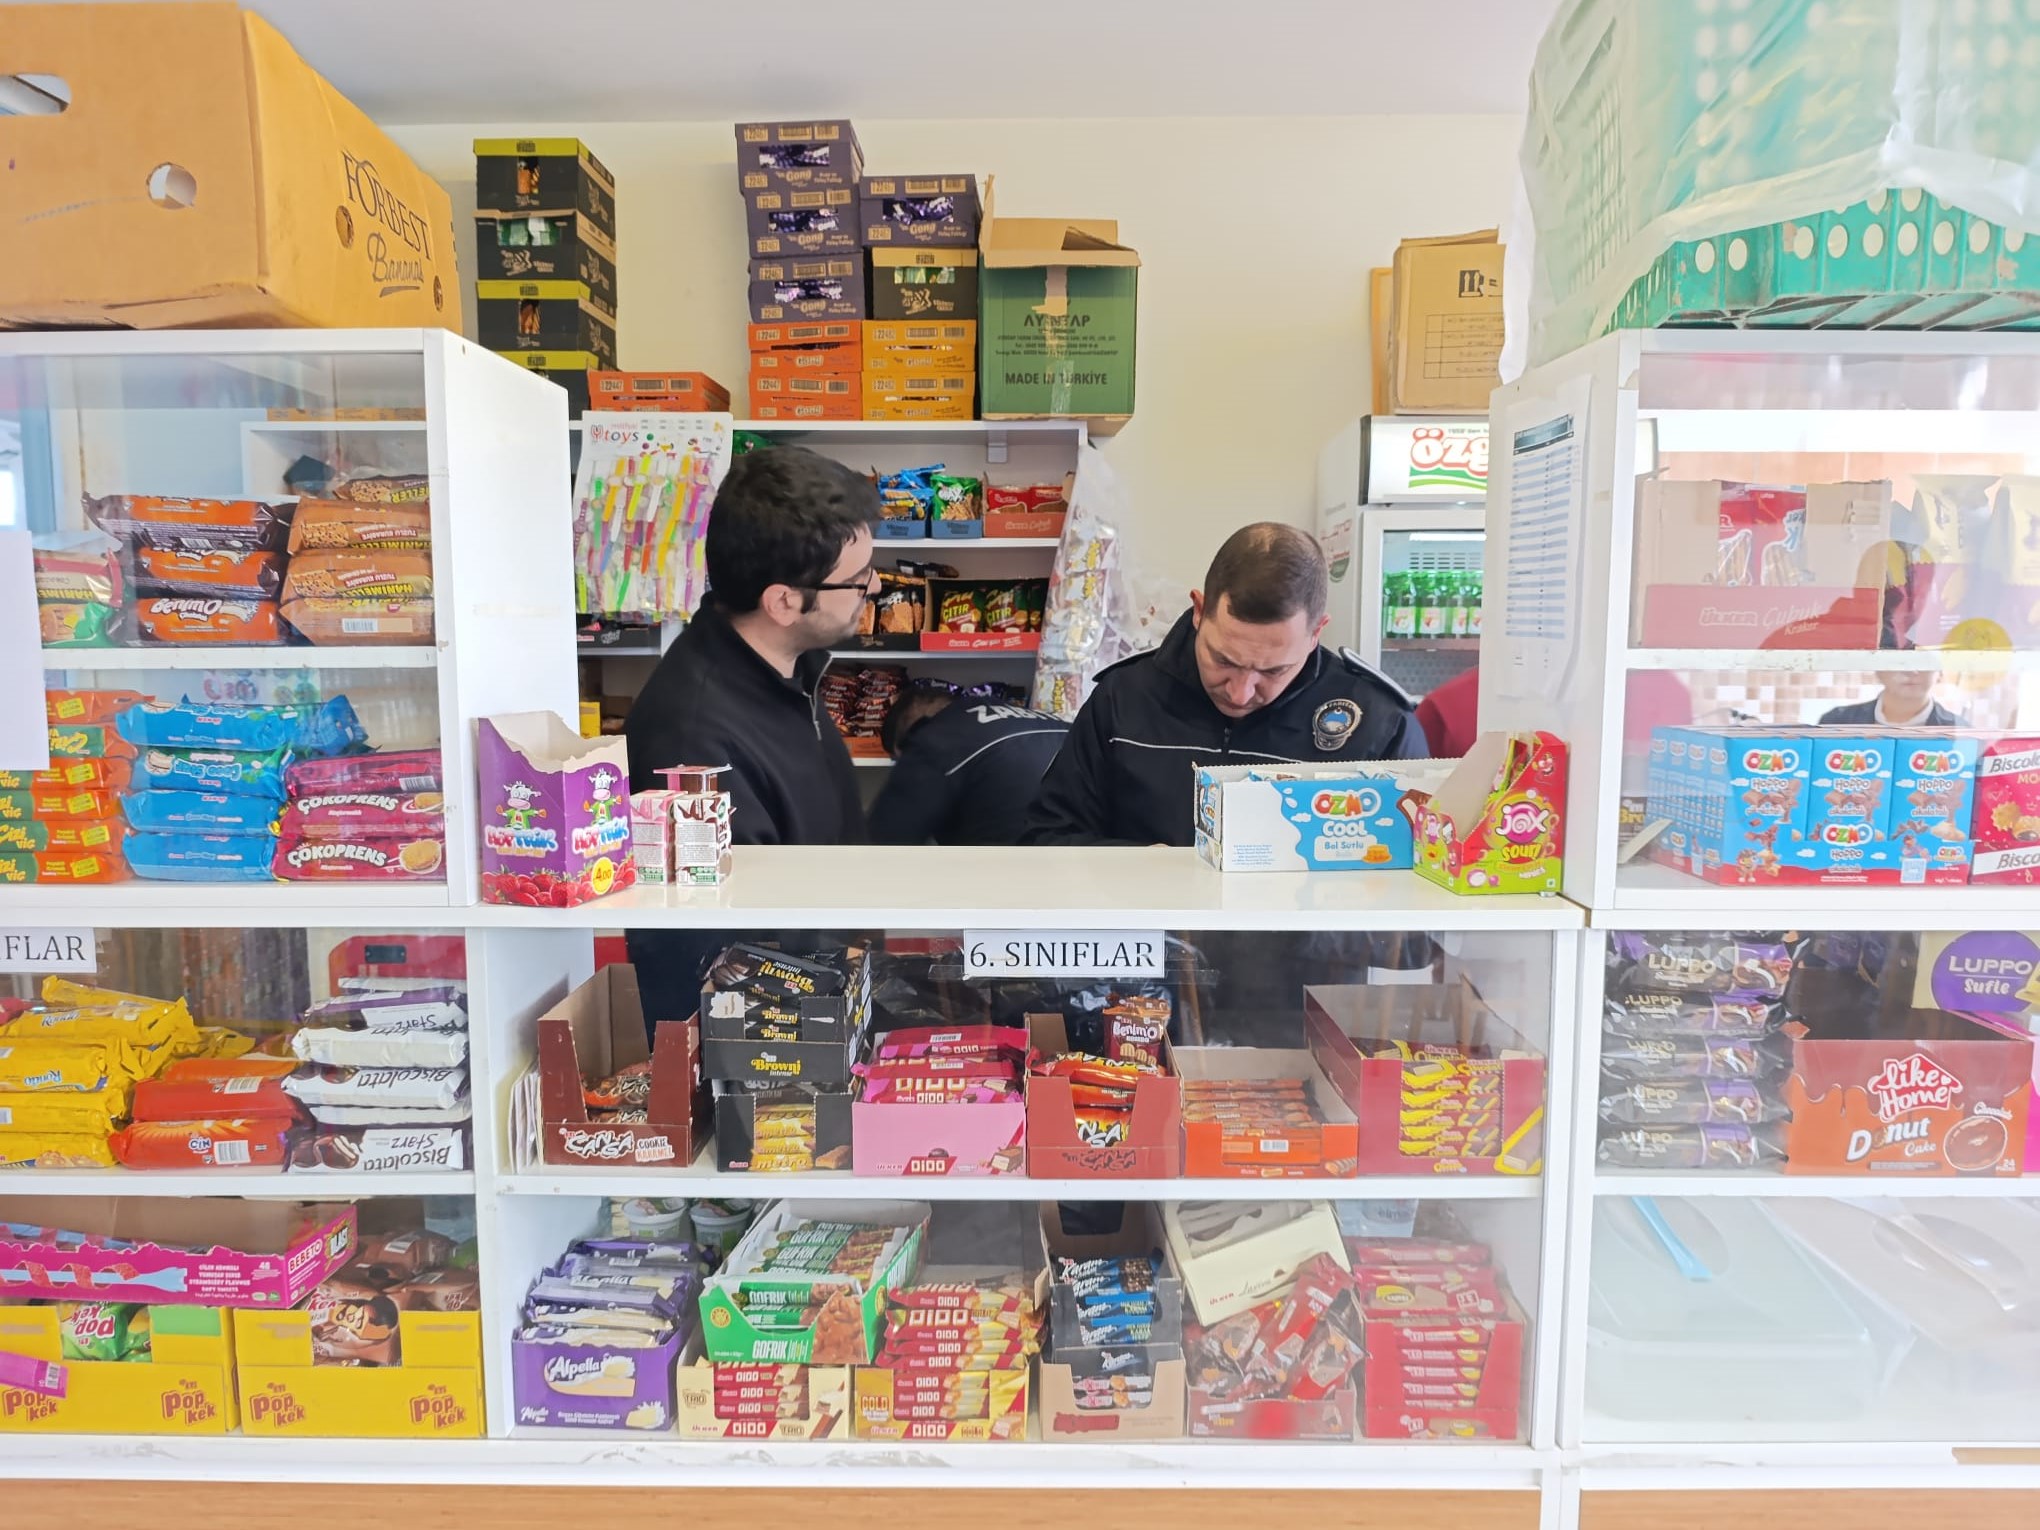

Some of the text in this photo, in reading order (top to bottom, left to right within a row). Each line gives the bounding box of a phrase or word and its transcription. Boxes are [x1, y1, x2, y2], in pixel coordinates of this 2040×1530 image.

[341, 151, 431, 261] FORBEST
[367, 232, 424, 283] Bananas
[1005, 373, 1039, 385] MADE
[1044, 373, 1055, 385] IN
[604, 431, 640, 444] toys
[943, 603, 970, 622] ÇITIR
[986, 607, 1012, 626] ÇITIR
[1745, 751, 1797, 773] OZMO
[1828, 752, 1879, 774] OZMO
[1912, 752, 1962, 774] OZMO
[298, 794, 399, 815] ÇOKOPRENS
[1315, 791, 1379, 817] OZMO
[1323, 821, 1367, 837] COOL
[1825, 824, 1871, 844] OZMO
[1324, 842, 1338, 850] Bal
[288, 845, 388, 868] ÇOKOPRENS
[1997, 850, 2040, 869] Bisco
[5, 935, 86, 961] FLAR
[970, 942, 1155, 967] 6. SINIFLAR
[1649, 953, 1717, 974] LUPPO
[1949, 956, 2033, 975] LUPPO
[396, 1014, 437, 1029] Starz
[751, 1058, 801, 1075] Browni
[1886, 1056, 1939, 1088] like
[357, 1069, 453, 1089] Biscolata
[1881, 1086, 1949, 1121] Home
[392, 1133, 438, 1149] Starz
[567, 1130, 633, 1158] CANGA
[1078, 1121, 1122, 1148] NGA
[1847, 1118, 1931, 1161] Donut
[364, 1145, 451, 1172] Biscolata
[1905, 1142, 1936, 1157] Cake
[911, 1160, 945, 1172] DIDO
[289, 1240, 322, 1273] BEBETO
[938, 1297, 959, 1307] DIDO
[72, 1305, 101, 1325] kek
[909, 1309, 968, 1326] DIDO
[75, 1317, 116, 1337] pop
[936, 1329, 959, 1340] DIDO
[752, 1340, 787, 1361] GOFRIK
[938, 1343, 961, 1353] DIDO
[549, 1357, 601, 1382] Alpella
[928, 1356, 952, 1367] DIDO
[736, 1372, 759, 1382] DIDO
[916, 1377, 939, 1387] DIDO
[740, 1388, 763, 1398] DIDO
[861, 1396, 890, 1410] GOLD
[917, 1392, 940, 1402] DIDO
[28, 1399, 58, 1422] kek
[163, 1392, 205, 1419] pop
[187, 1403, 216, 1425] kek
[252, 1394, 294, 1421] pop
[412, 1396, 454, 1422] pop
[738, 1403, 761, 1414] DIDO
[912, 1406, 936, 1416] DIDO
[276, 1406, 306, 1427] kek
[436, 1406, 467, 1428] kek
[732, 1422, 766, 1434] DIDO
[912, 1424, 946, 1437] DIDO
